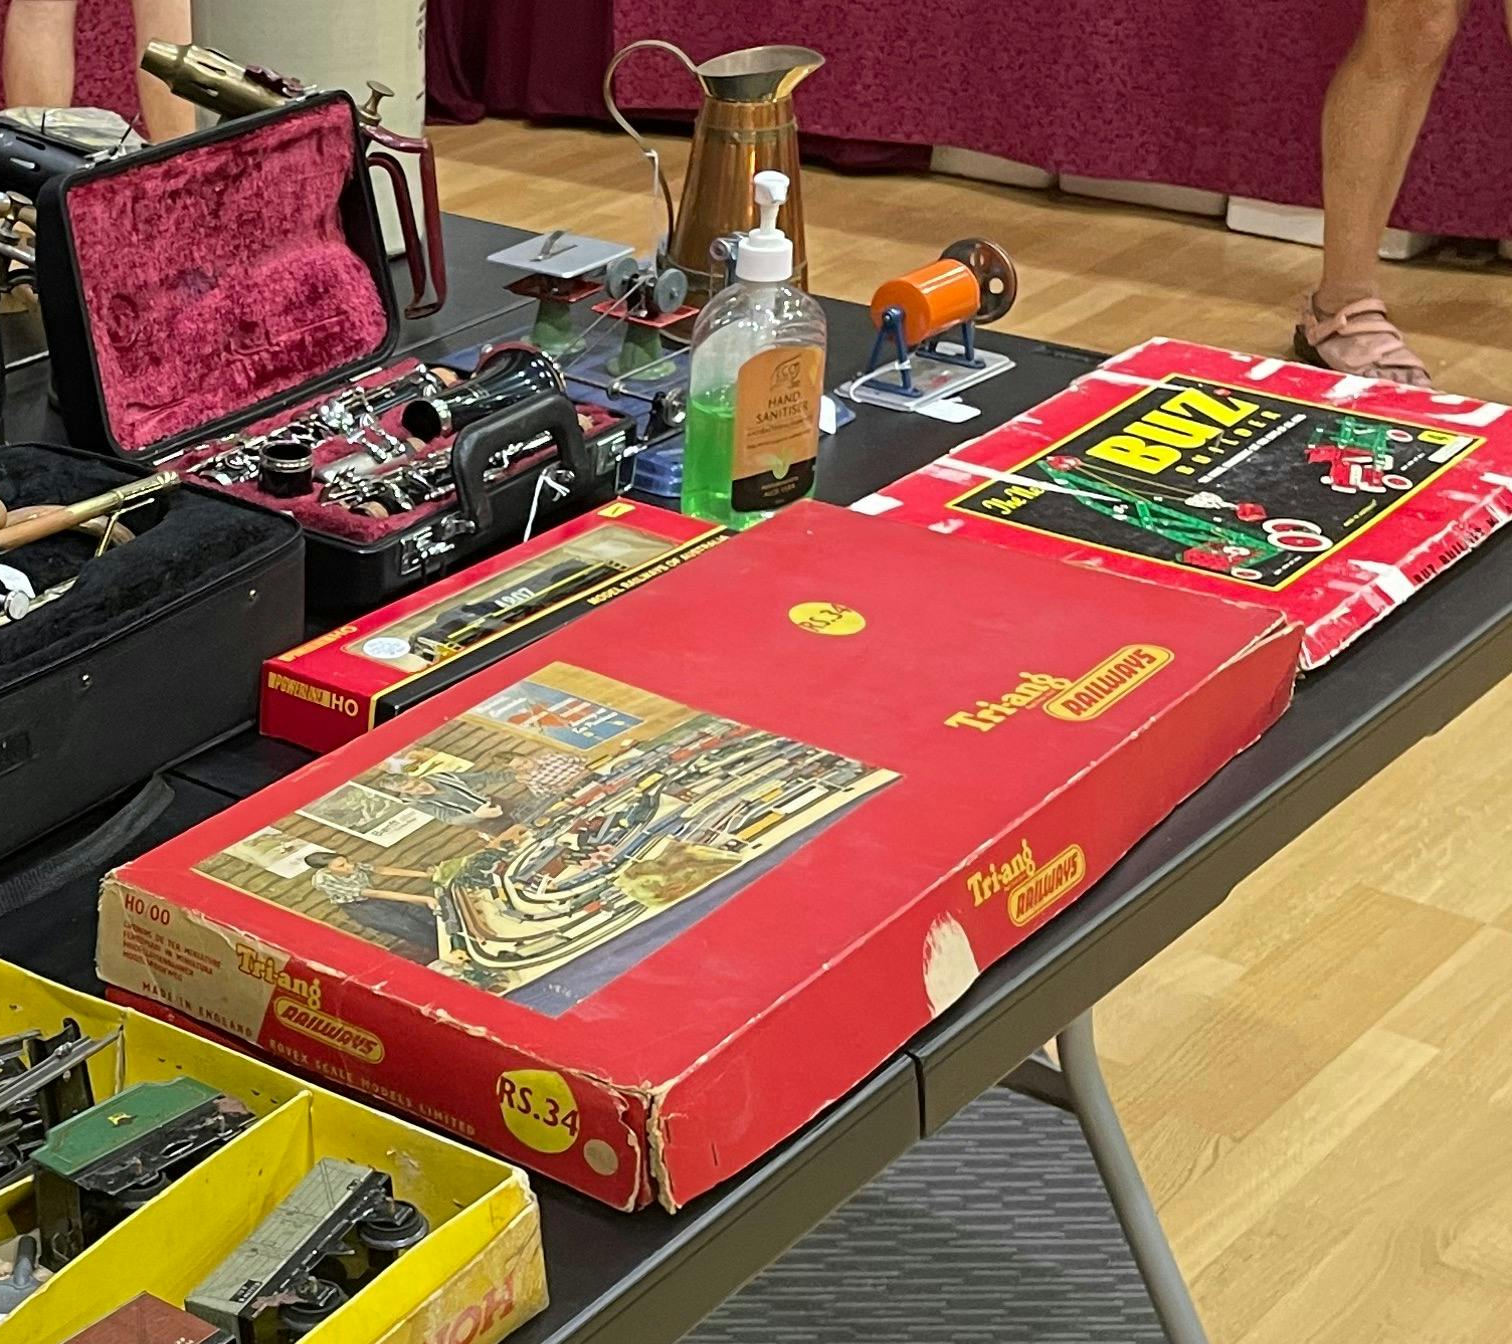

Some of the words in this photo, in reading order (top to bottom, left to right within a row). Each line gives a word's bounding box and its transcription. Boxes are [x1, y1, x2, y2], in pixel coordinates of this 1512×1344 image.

[768, 391, 801, 408] HAND
[1085, 387, 1261, 475] BUZ
[331, 692, 359, 717] HO
[1061, 648, 1158, 717] RAILWAYS
[967, 838, 1037, 907] Tri-ang
[1016, 852, 1079, 920] RAILWAYS
[236, 943, 322, 1010] Tri-ang
[199, 1006, 253, 1038] ENGLAND
[280, 1003, 378, 1056] RAILWAYS
[269, 1038, 309, 1064] ROVEX
[315, 1057, 352, 1083] SCALE
[361, 1077, 413, 1108] MODELS
[419, 1102, 476, 1136] LIMITED
[499, 1076, 579, 1137] RS.34
